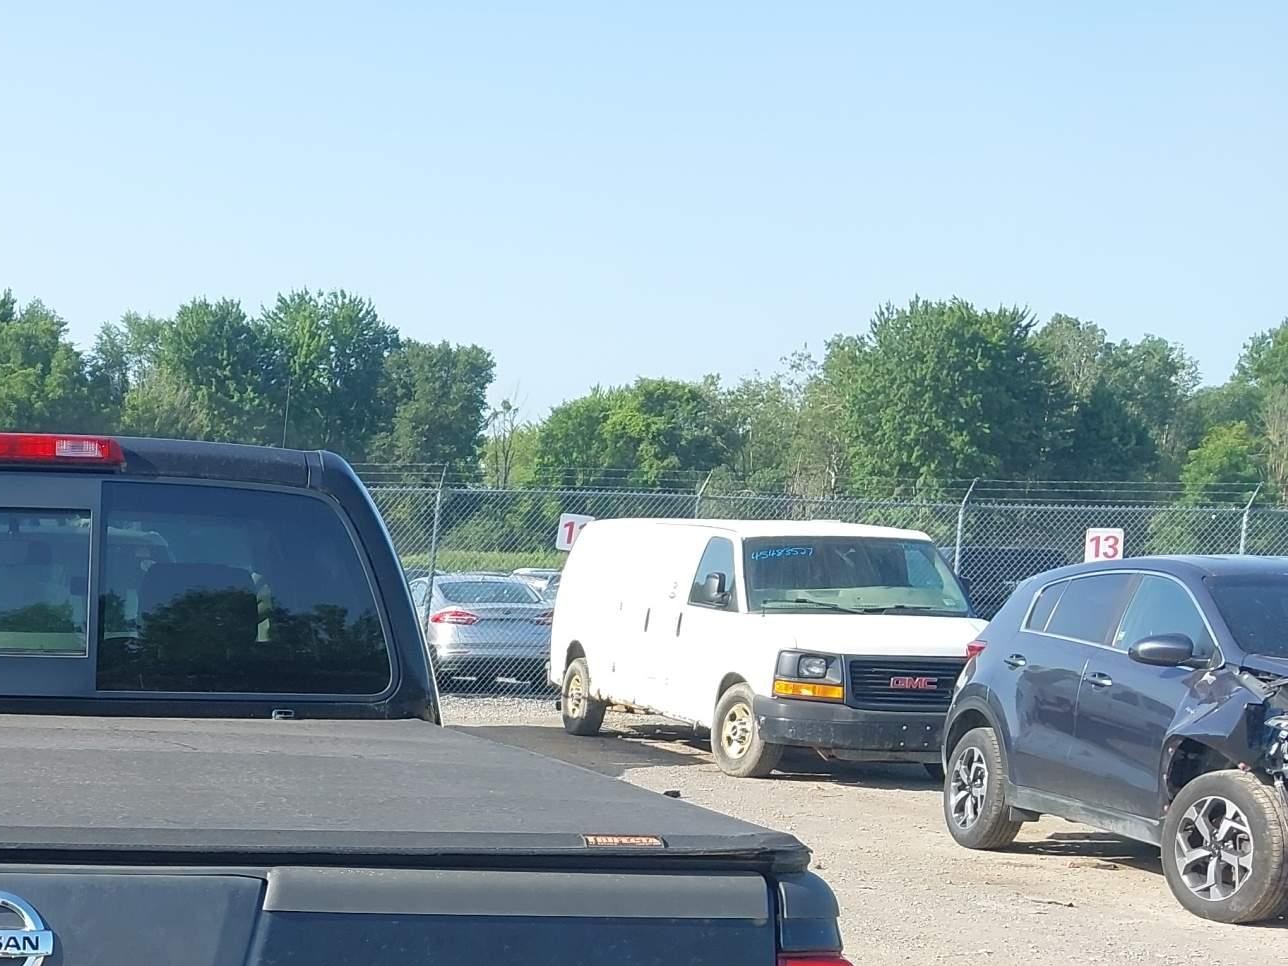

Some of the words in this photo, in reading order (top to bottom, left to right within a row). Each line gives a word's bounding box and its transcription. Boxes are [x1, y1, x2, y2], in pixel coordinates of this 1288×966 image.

[563, 521, 587, 545] 1
[1089, 535, 1120, 559] 13
[889, 676, 937, 690] GMC
